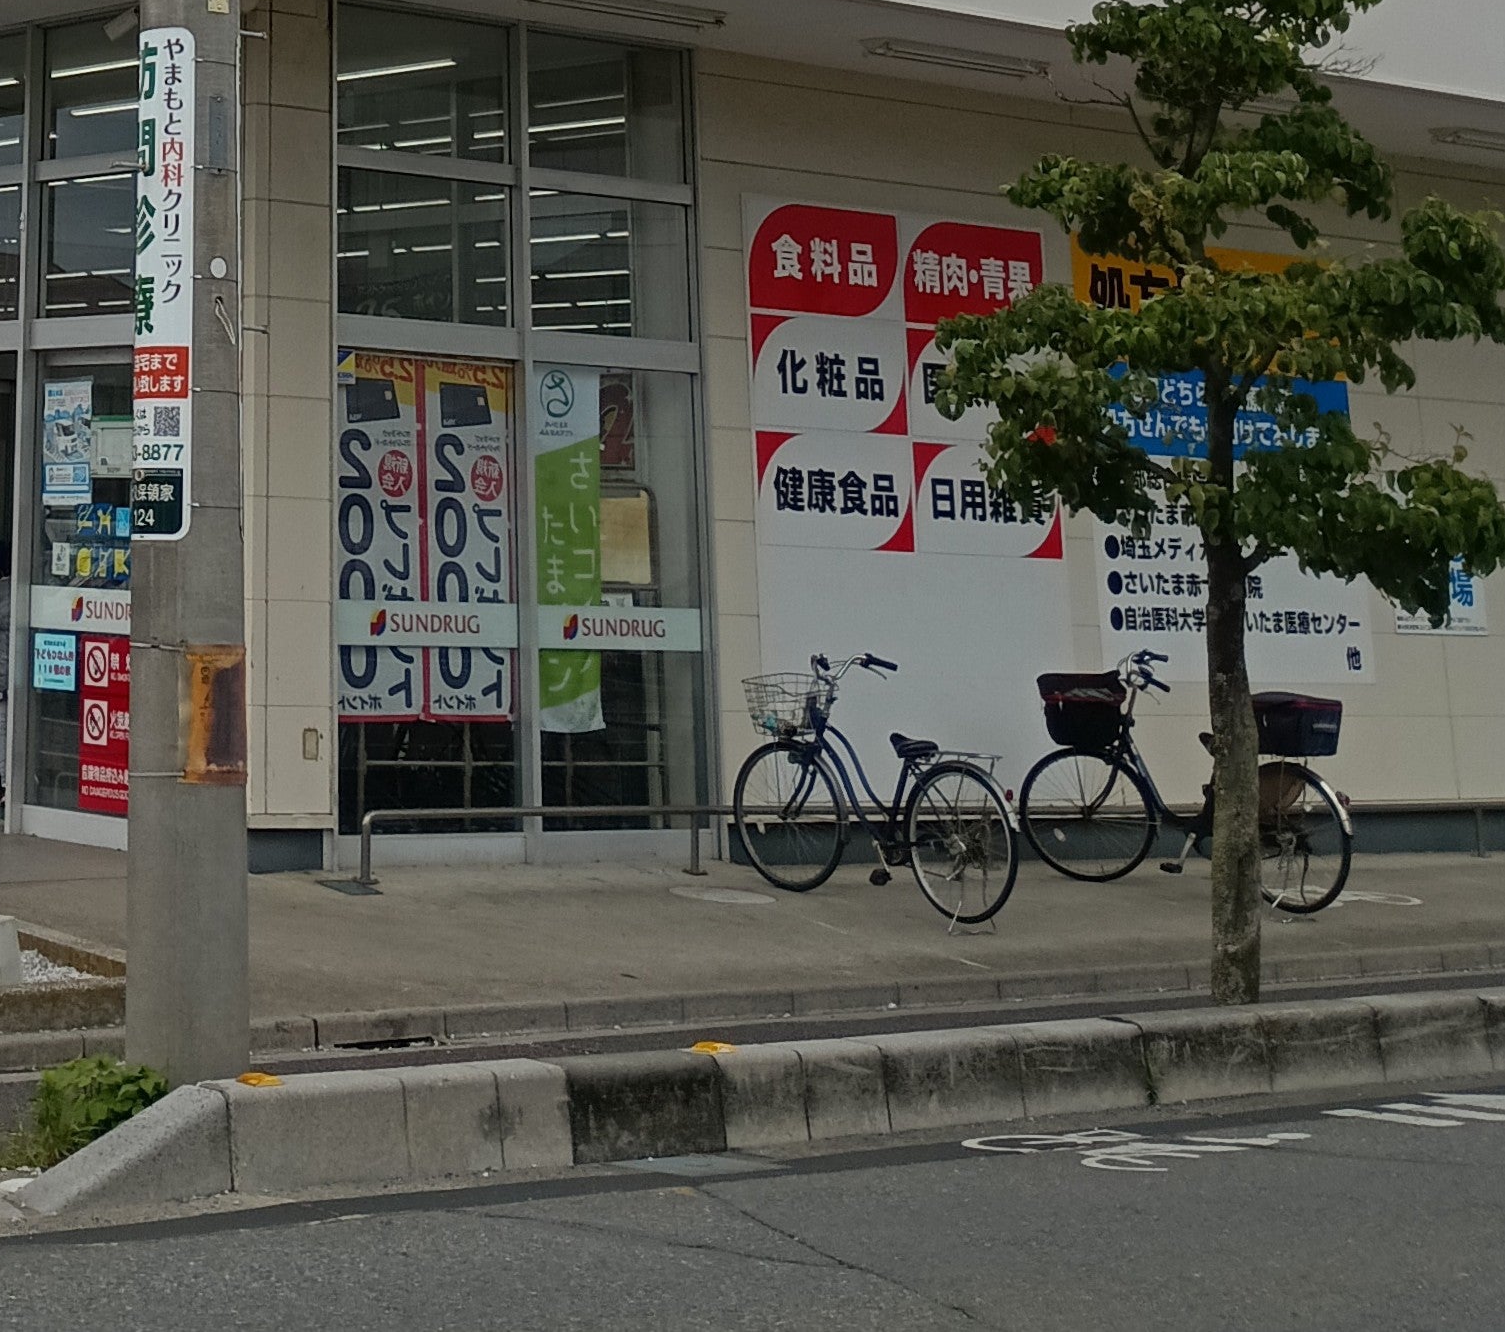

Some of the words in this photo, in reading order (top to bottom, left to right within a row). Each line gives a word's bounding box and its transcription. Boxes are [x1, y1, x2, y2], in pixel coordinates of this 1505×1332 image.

[160, 37, 185, 304] やまもと内科クリニック
[771, 233, 879, 287] 食料品
[911, 247, 1034, 302] 精肉・青果
[776, 348, 885, 402] 化粧品
[773, 464, 900, 518] 健康食品
[1124, 571, 1264, 600] さいたま赤院
[390, 613, 481, 634] SUNDRUG
[582, 617, 666, 638] SUNDRUG
[1124, 605, 1361, 635] 自治医科大学いたま医療センター
[1346, 646, 1362, 671] 他
